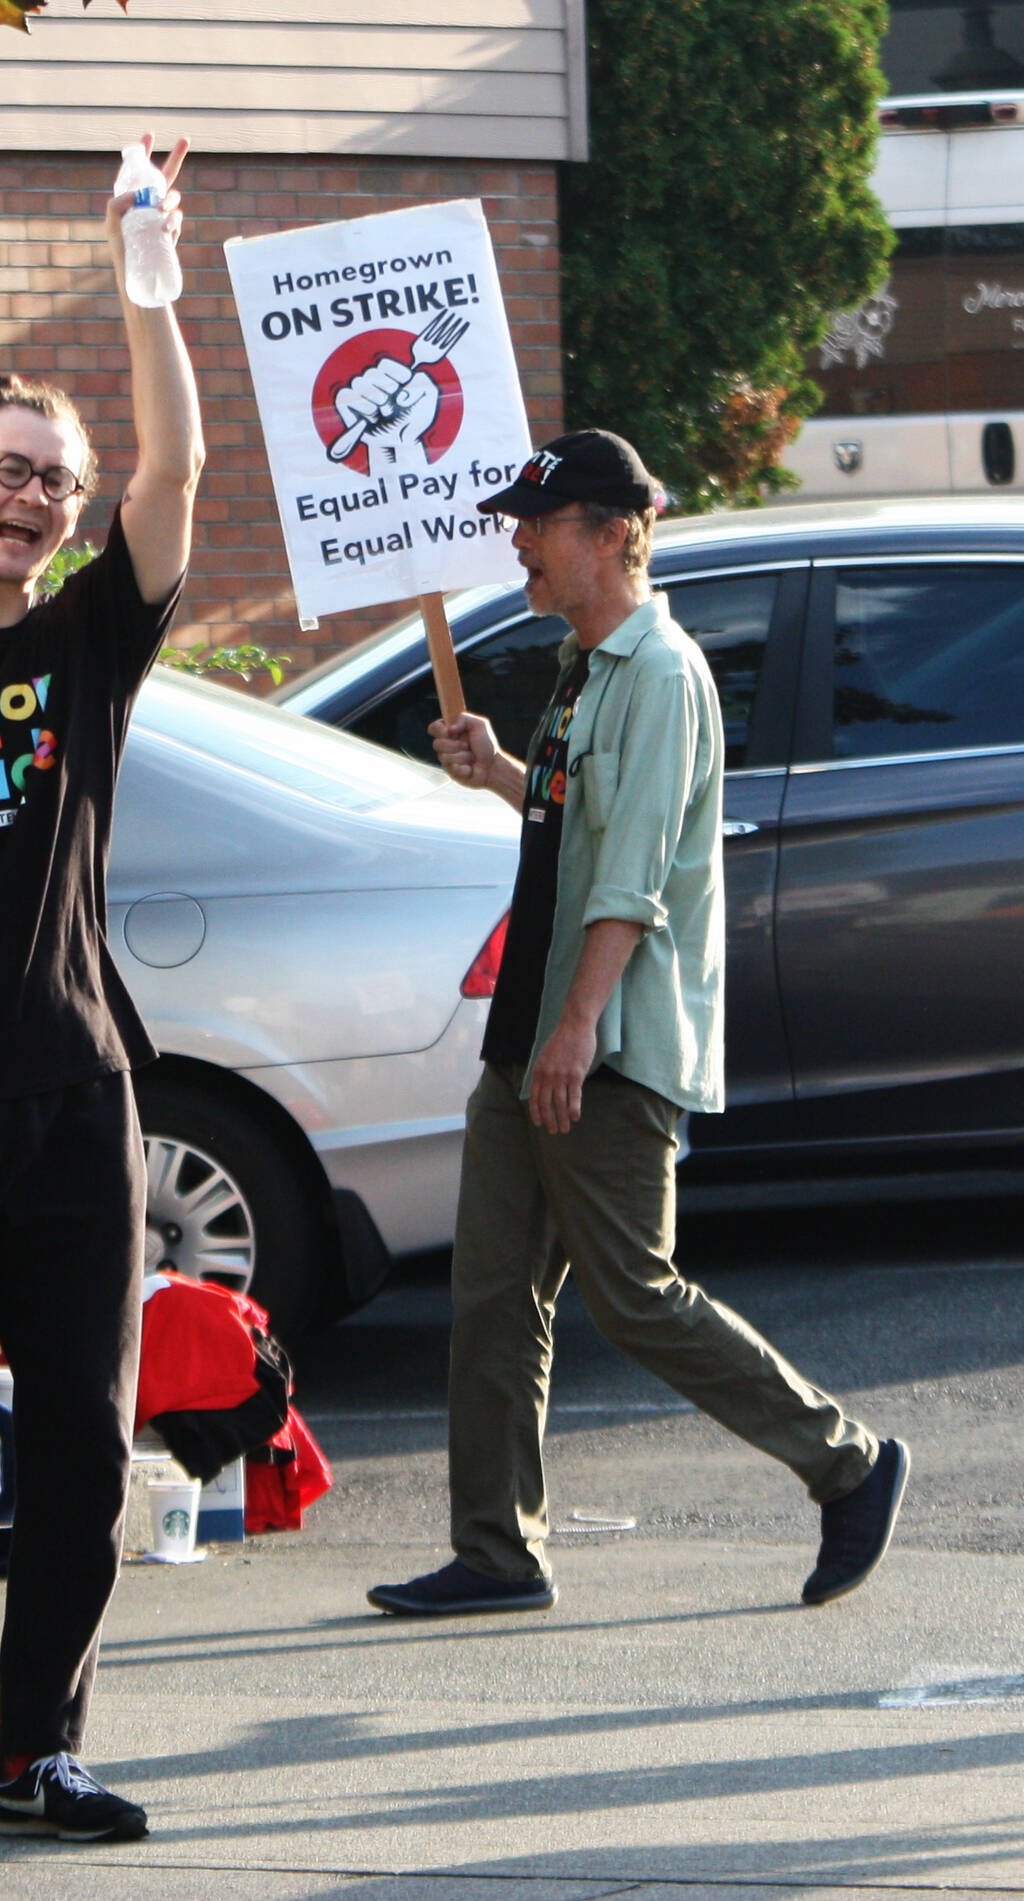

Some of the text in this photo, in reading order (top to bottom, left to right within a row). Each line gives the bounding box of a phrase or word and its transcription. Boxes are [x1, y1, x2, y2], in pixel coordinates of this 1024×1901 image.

[272, 249, 453, 296] Homegrown
[261, 273, 480, 341] ON STRIKE!
[296, 459, 516, 523] Equal Pay for
[320, 521, 414, 567] Equal
